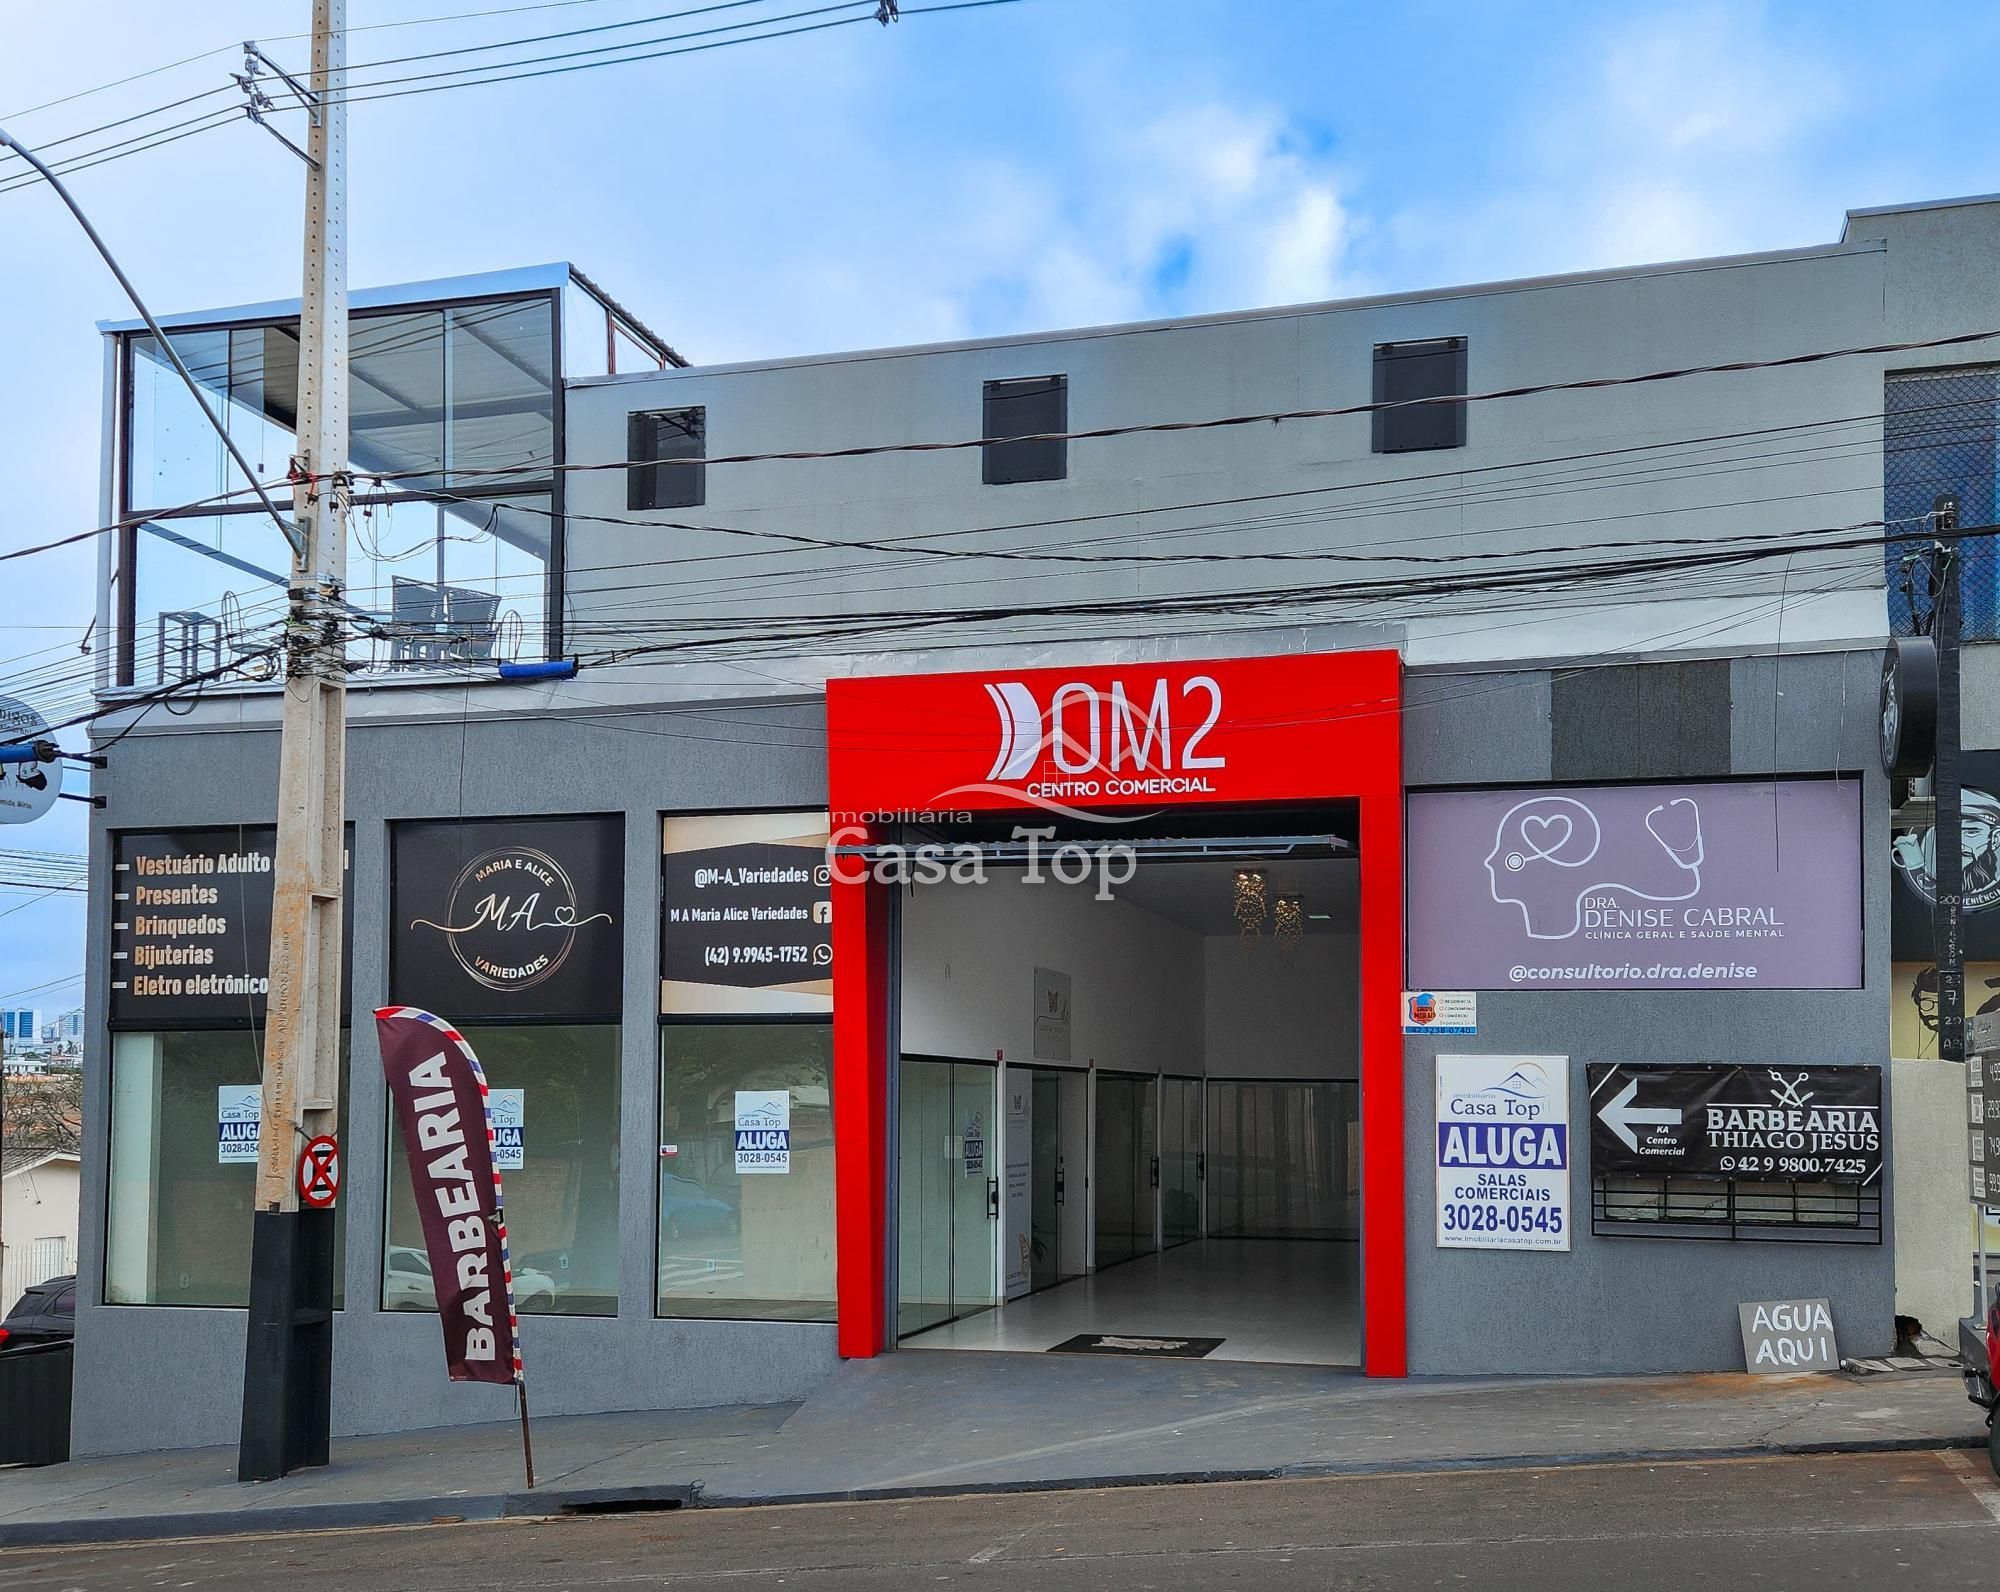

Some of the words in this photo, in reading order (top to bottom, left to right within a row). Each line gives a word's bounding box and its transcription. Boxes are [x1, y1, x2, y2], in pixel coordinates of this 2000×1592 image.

[1027, 780, 1100, 798] CENTRO
[1105, 777, 1216, 795] COMERCIAL
[136, 855, 214, 875] Vestuário
[217, 852, 270, 873] Adulto
[475, 859, 512, 882] MARIA
[515, 859, 523, 869] E
[524, 862, 554, 887] ALICE
[695, 867, 809, 888] @M-A_Variedades
[136, 884, 218, 905] Presentes
[1585, 897, 1620, 909] DRA.
[1962, 888, 2000, 906] ENIÊNCI
[670, 910, 679, 922] M
[682, 910, 689, 922] A
[692, 908, 721, 922] Maria
[723, 907, 749, 921] Alice
[751, 907, 808, 921] Variedades
[1585, 908, 1674, 928] DENISE
[1683, 907, 1784, 927] CABRAL
[136, 914, 226, 939] Brinquedos
[1585, 930, 1632, 939] CLÍNICA
[1637, 931, 1674, 939] GERAL
[1690, 928, 1731, 938] SAÚDE
[1736, 929, 1784, 938] MENTAL
[134, 944, 213, 969] Bijuterias
[704, 946, 729, 966] (42)
[732, 946, 808, 964] 9.9945-1752
[473, 954, 549, 979] VARIEDADES
[1509, 962, 1757, 982] @consultorio.dra.denise
[133, 975, 182, 995] Eletro
[185, 973, 269, 995] eletrônico
[221, 1111, 241, 1119] Casa
[243, 1109, 259, 1120] Top
[1451, 1098, 1497, 1115] Casa
[1504, 1099, 1540, 1120] Top
[499, 1115, 515, 1125] Top
[738, 1117, 760, 1126] Casa
[763, 1117, 781, 1128] Top
[1656, 1126, 1669, 1134] KA
[1706, 1109, 1879, 1132] BARBEARIA
[221, 1123, 260, 1140] ALUG
[495, 1129, 522, 1146] UGA
[737, 1132, 787, 1149] ALUGA
[1646, 1136, 1677, 1144] Centro
[220, 1142, 259, 1153] 3028-054
[1443, 1126, 1562, 1166] ALUGA
[1639, 1147, 1685, 1156] Comercial
[1706, 1131, 1804, 1149] THIAGO
[1810, 1133, 1879, 1153] JESUS
[497, 1149, 521, 1159] -0545
[738, 1153, 787, 1163] 3028-0545
[1738, 1157, 1759, 1171] 42
[1764, 1157, 1774, 1171] 9
[1779, 1157, 1866, 1173] 9800.7425
[1478, 1174, 1527, 1186] SALAS
[1455, 1187, 1551, 1201] COMERCIAIS
[408, 1051, 495, 1361] BARBEARIA
[1444, 1204, 1562, 1233] 3028-0545
[1752, 1304, 1833, 1333] AGUA
[1755, 1337, 1828, 1366] AQUI
